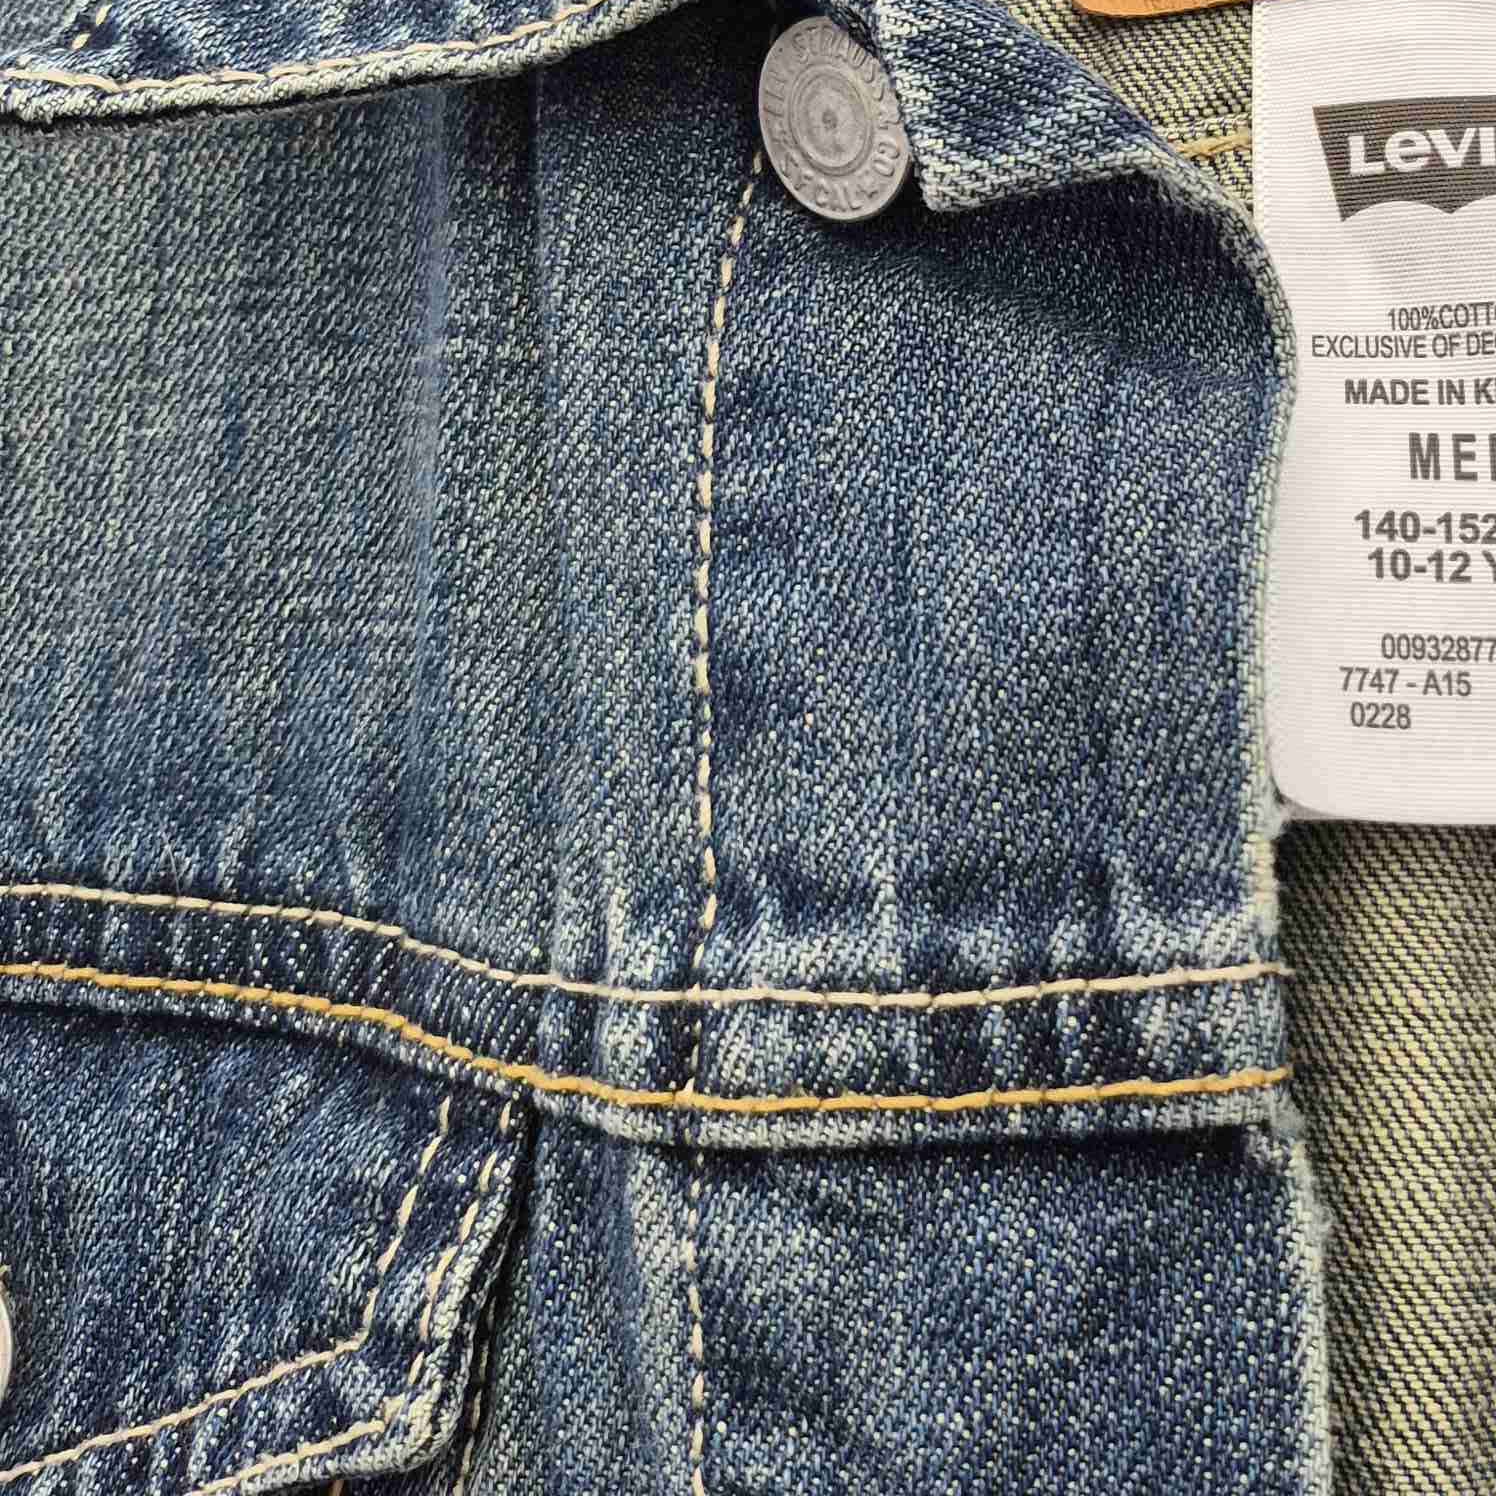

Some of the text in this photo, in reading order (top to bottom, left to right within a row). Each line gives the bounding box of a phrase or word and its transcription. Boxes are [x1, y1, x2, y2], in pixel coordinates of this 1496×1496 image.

[1311, 334, 1428, 359] EXCLUSIVE
[1432, 332, 1463, 358] OF
[1344, 378, 1430, 406] MADE
[1438, 377, 1466, 406] IN
[1367, 547, 1473, 583] 10-12
[1350, 701, 1412, 730] 0228
